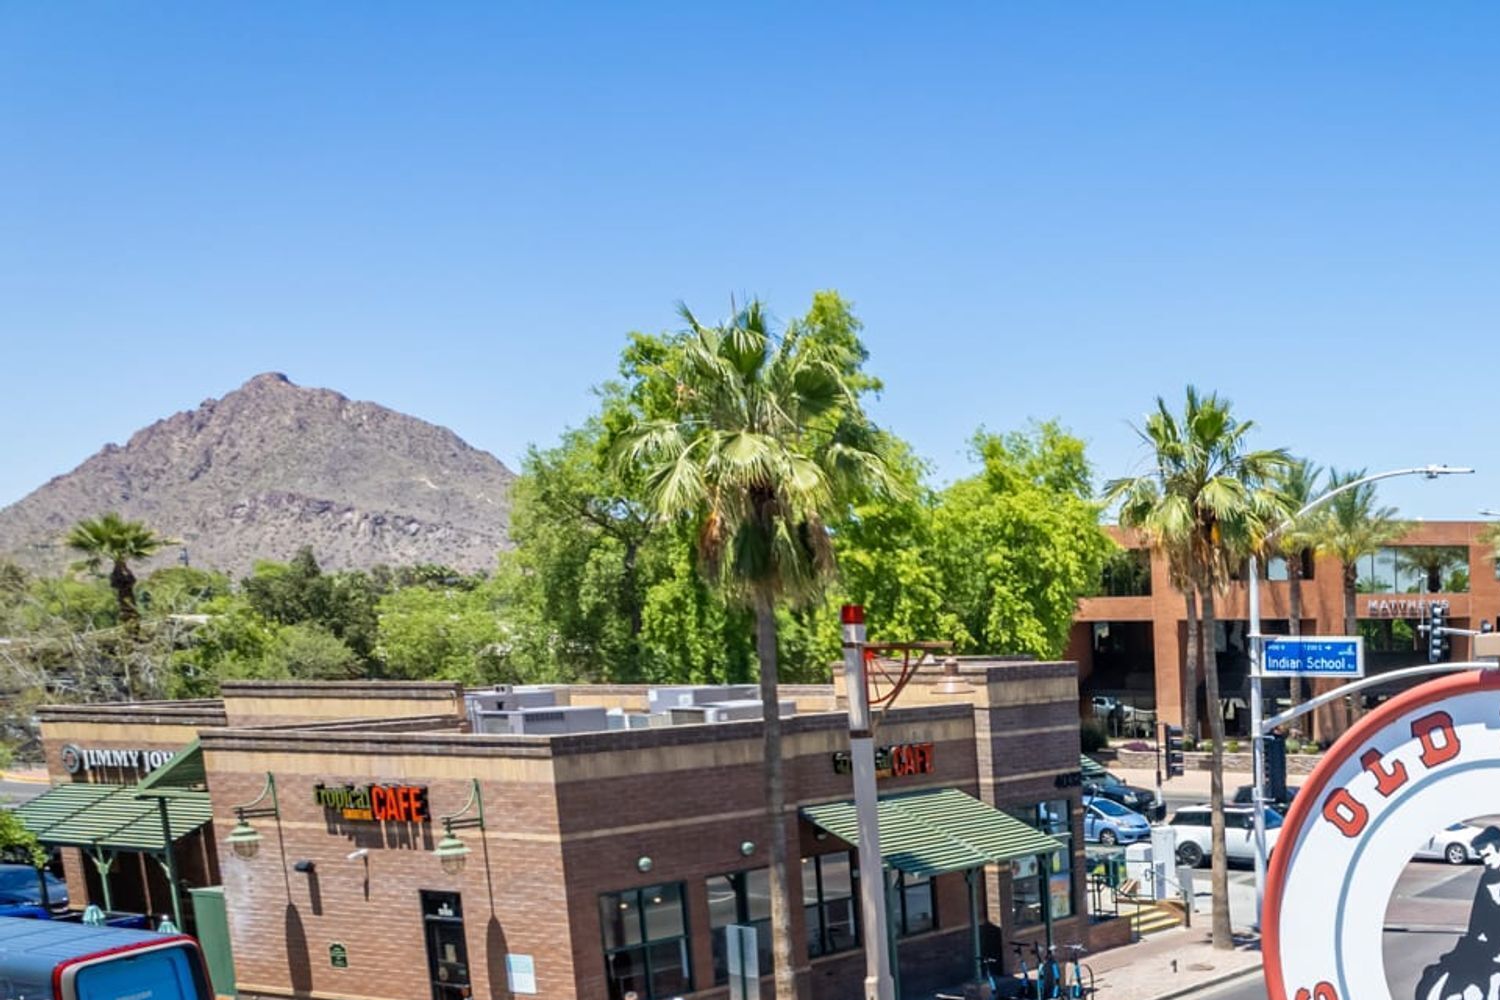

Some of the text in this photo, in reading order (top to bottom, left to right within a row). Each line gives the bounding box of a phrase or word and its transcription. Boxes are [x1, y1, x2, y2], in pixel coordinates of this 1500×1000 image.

[1268, 656, 1304, 669] Indian
[1306, 656, 1346, 669] School
[82, 748, 139, 771] JIMMY
[1322, 710, 1461, 838] OLD
[370, 784, 424, 823] CAFE
